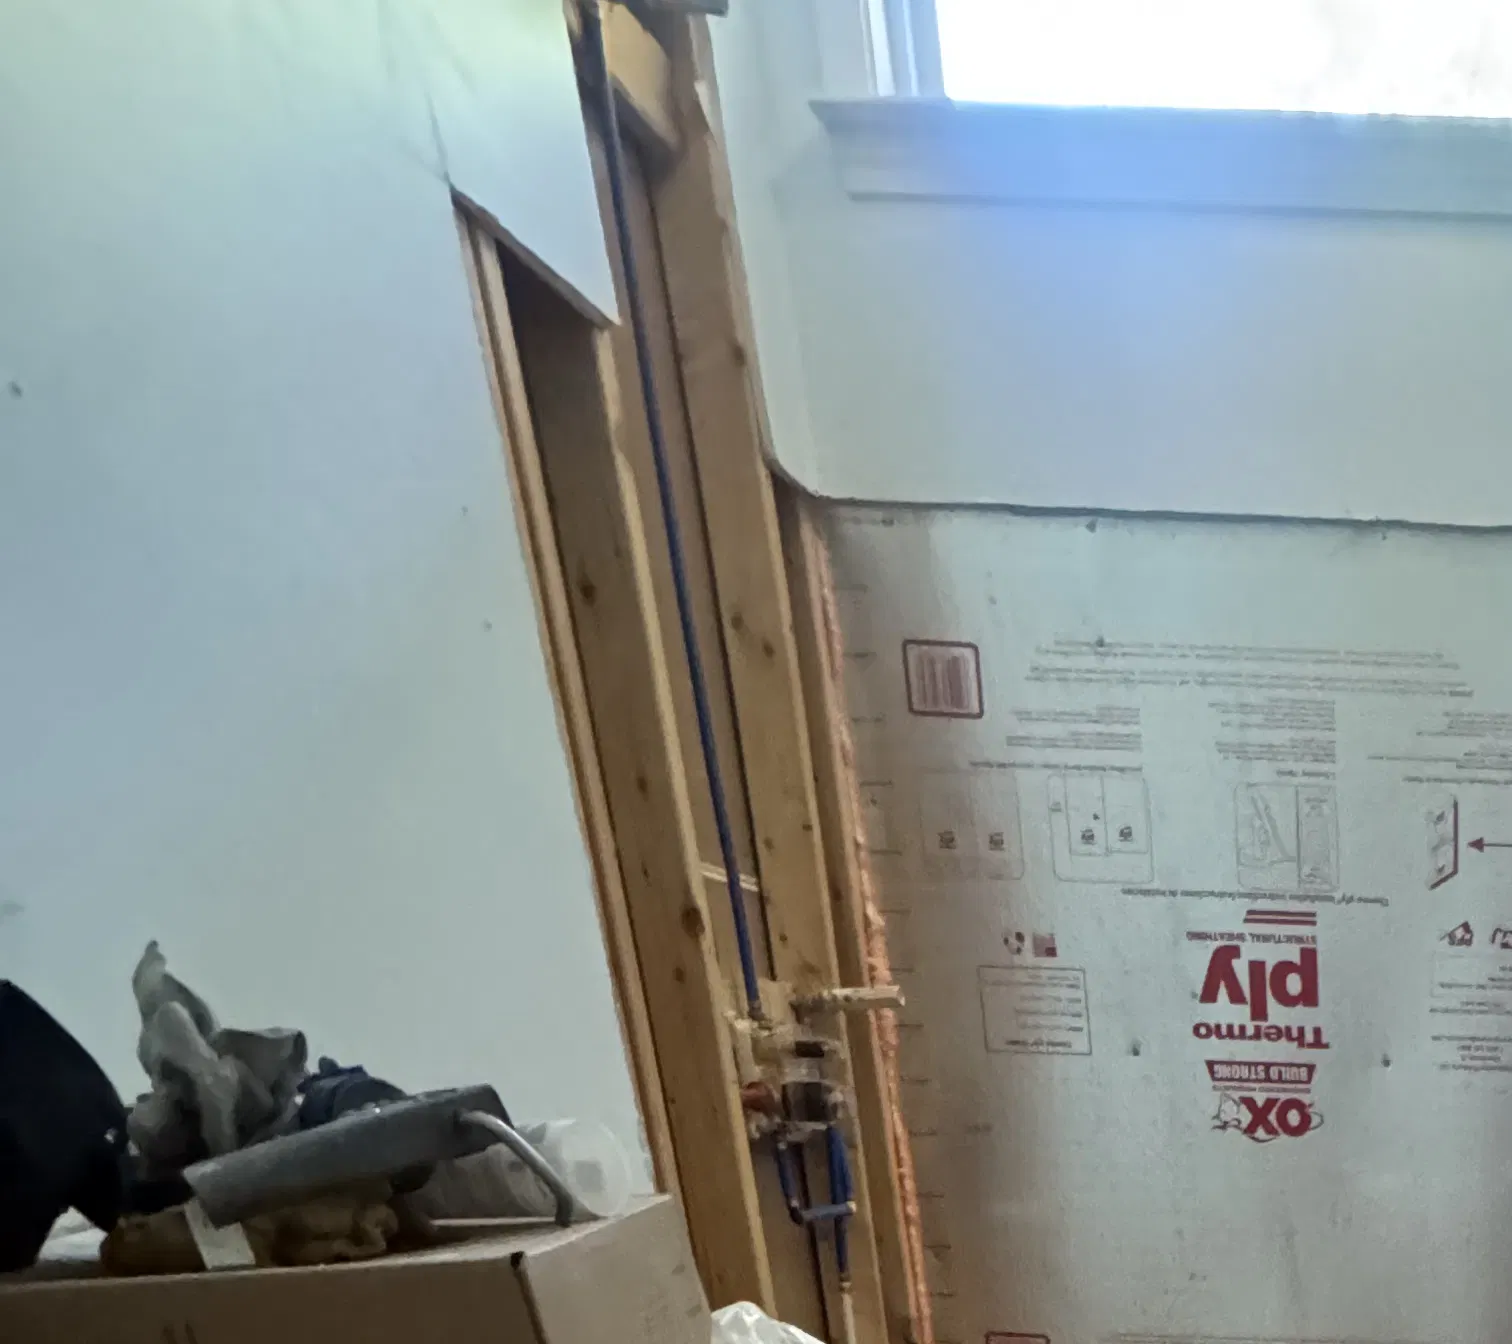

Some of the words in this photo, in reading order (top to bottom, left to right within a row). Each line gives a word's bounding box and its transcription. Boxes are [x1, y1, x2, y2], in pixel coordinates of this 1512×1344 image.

[1199, 944, 1320, 1022] ply
[1192, 1022, 1330, 1050] Thermo
[1213, 1063, 1266, 1080] STRONG
[1269, 1065, 1309, 1082] BUILD
[1238, 1096, 1312, 1137] OX
